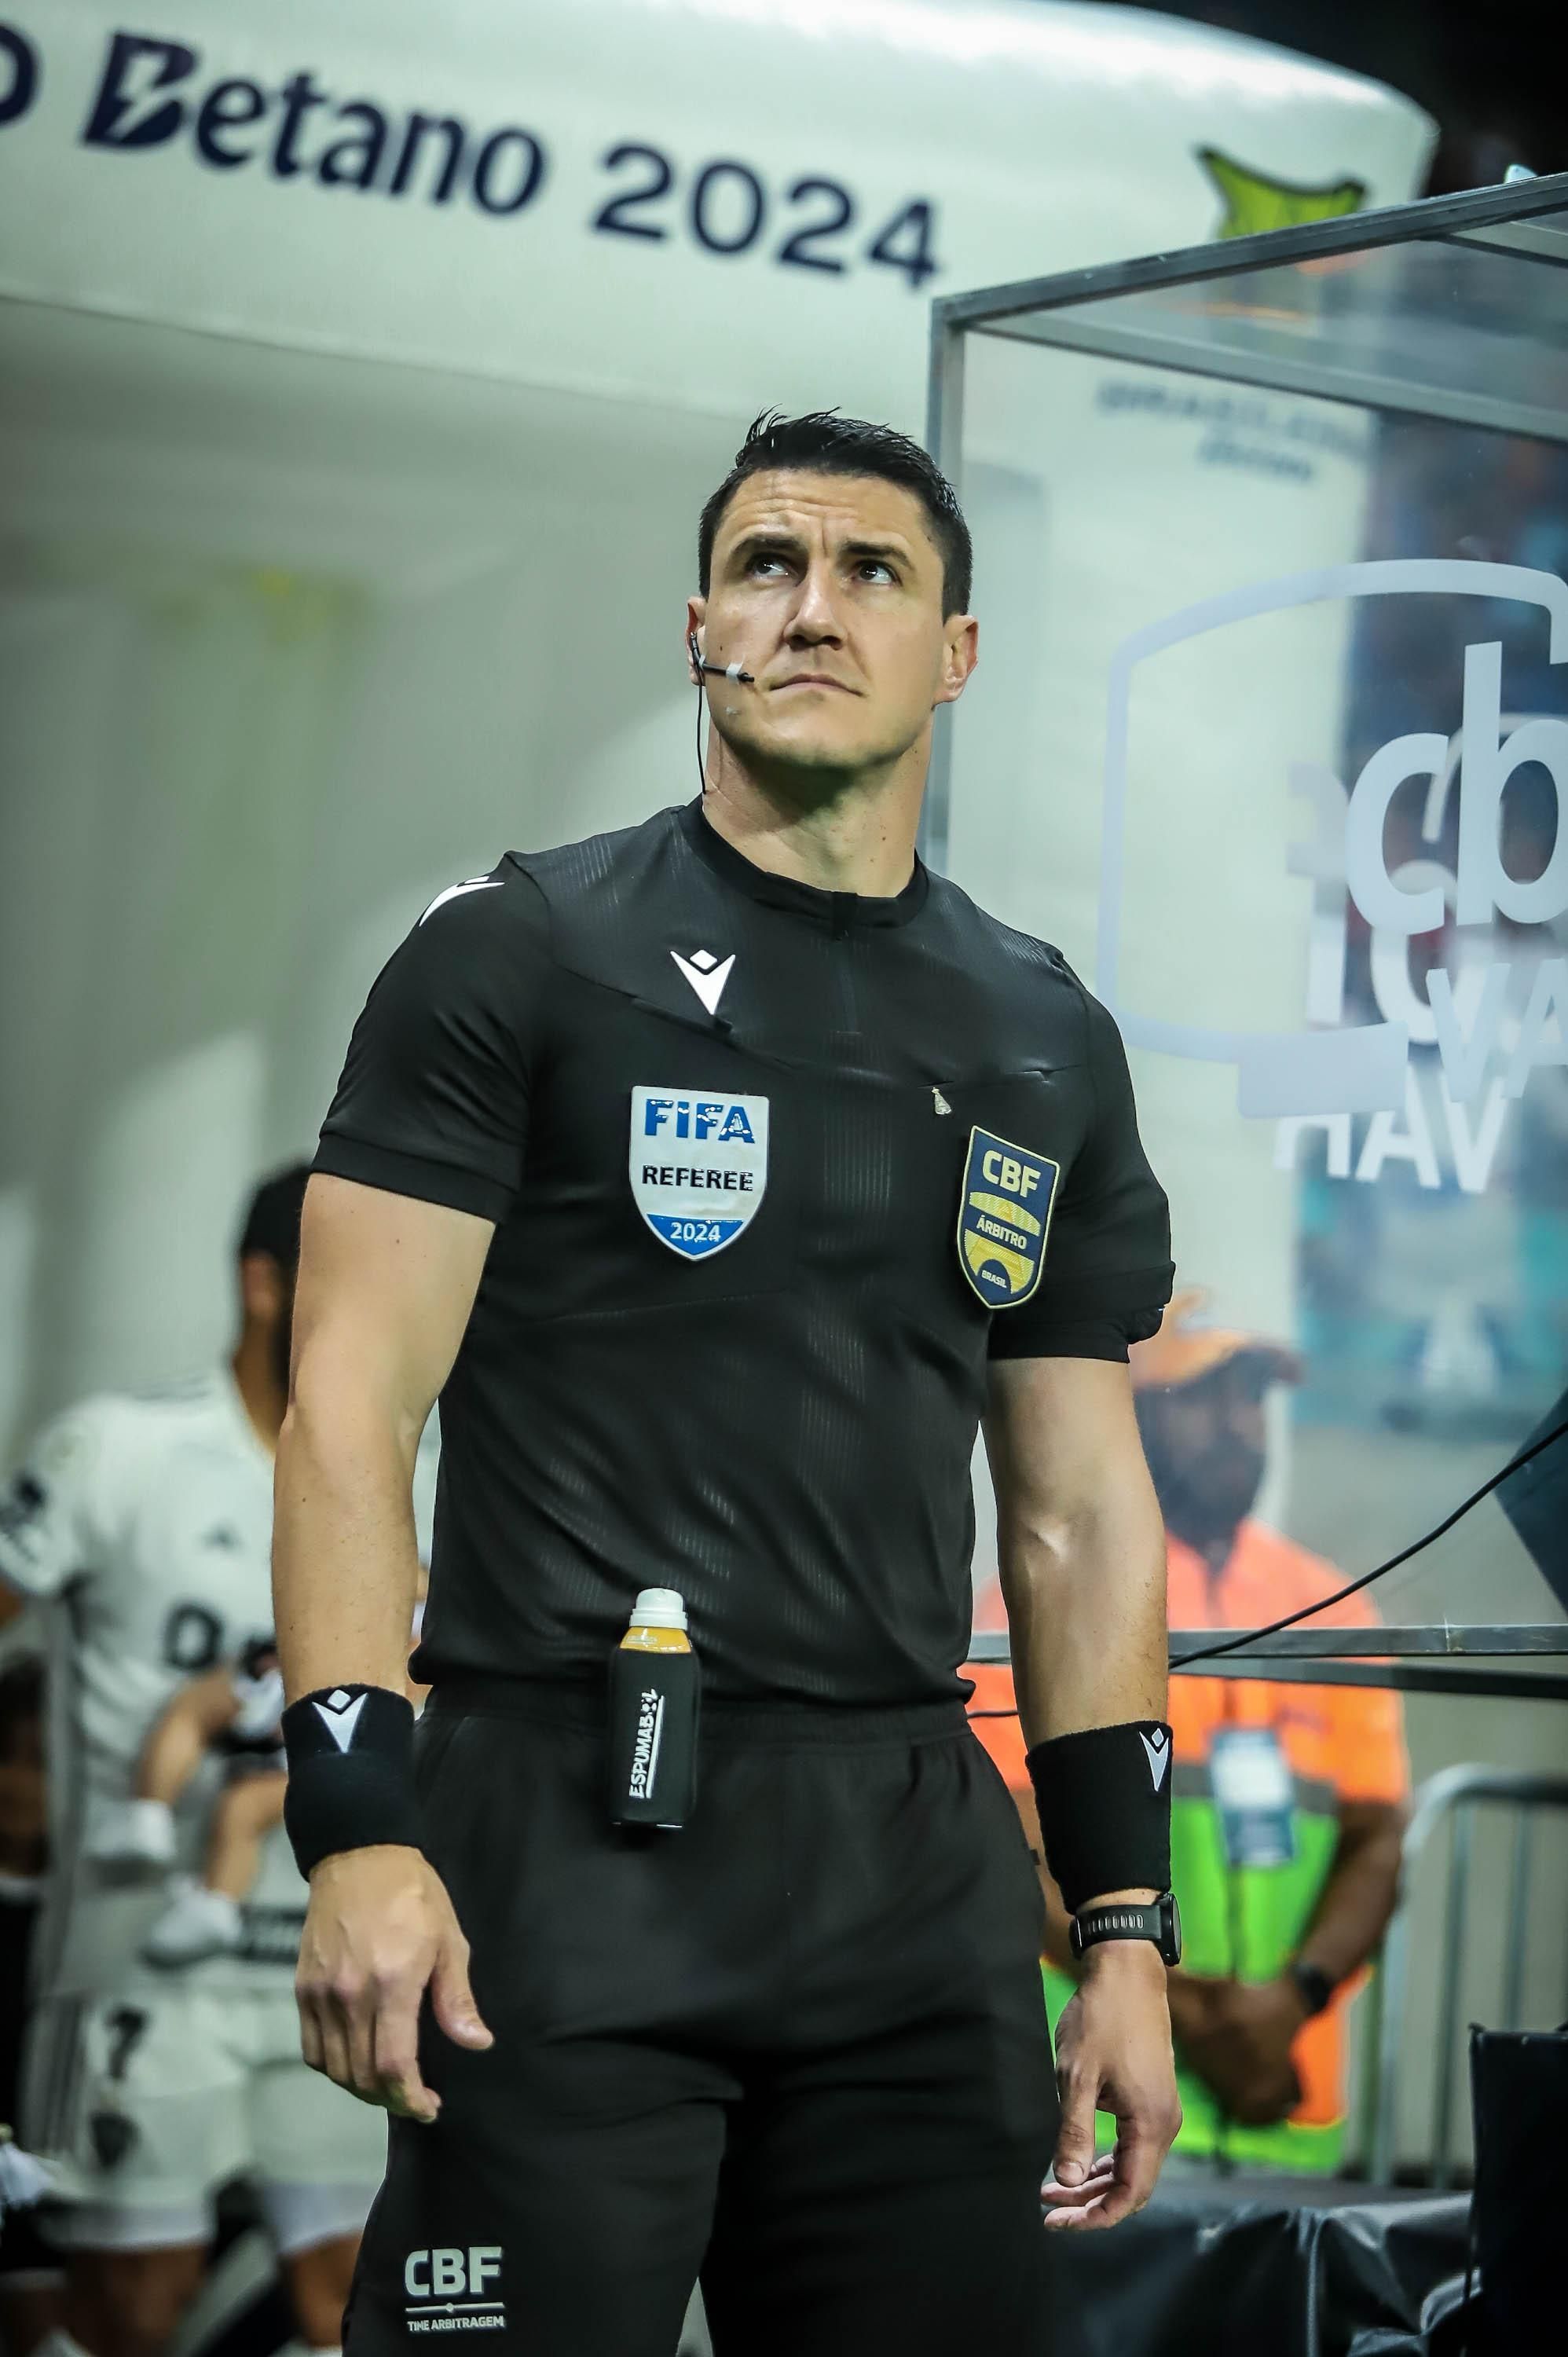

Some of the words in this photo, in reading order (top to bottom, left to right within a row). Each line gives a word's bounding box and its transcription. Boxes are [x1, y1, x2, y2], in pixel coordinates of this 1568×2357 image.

[81, 30, 548, 217] Betano
[591, 143, 942, 289] 2024
[644, 1098, 756, 1144] FIFA
[642, 1164, 753, 1192] REFEREE
[982, 1149, 1042, 1198] CBF
[669, 1221, 722, 1242] 2024
[976, 1215, 1028, 1250] ÁRBITRO
[405, 2246, 502, 2296] CBF
[407, 2319, 430, 2332] TIME
[430, 2315, 505, 2330] ARBITRAGEM
